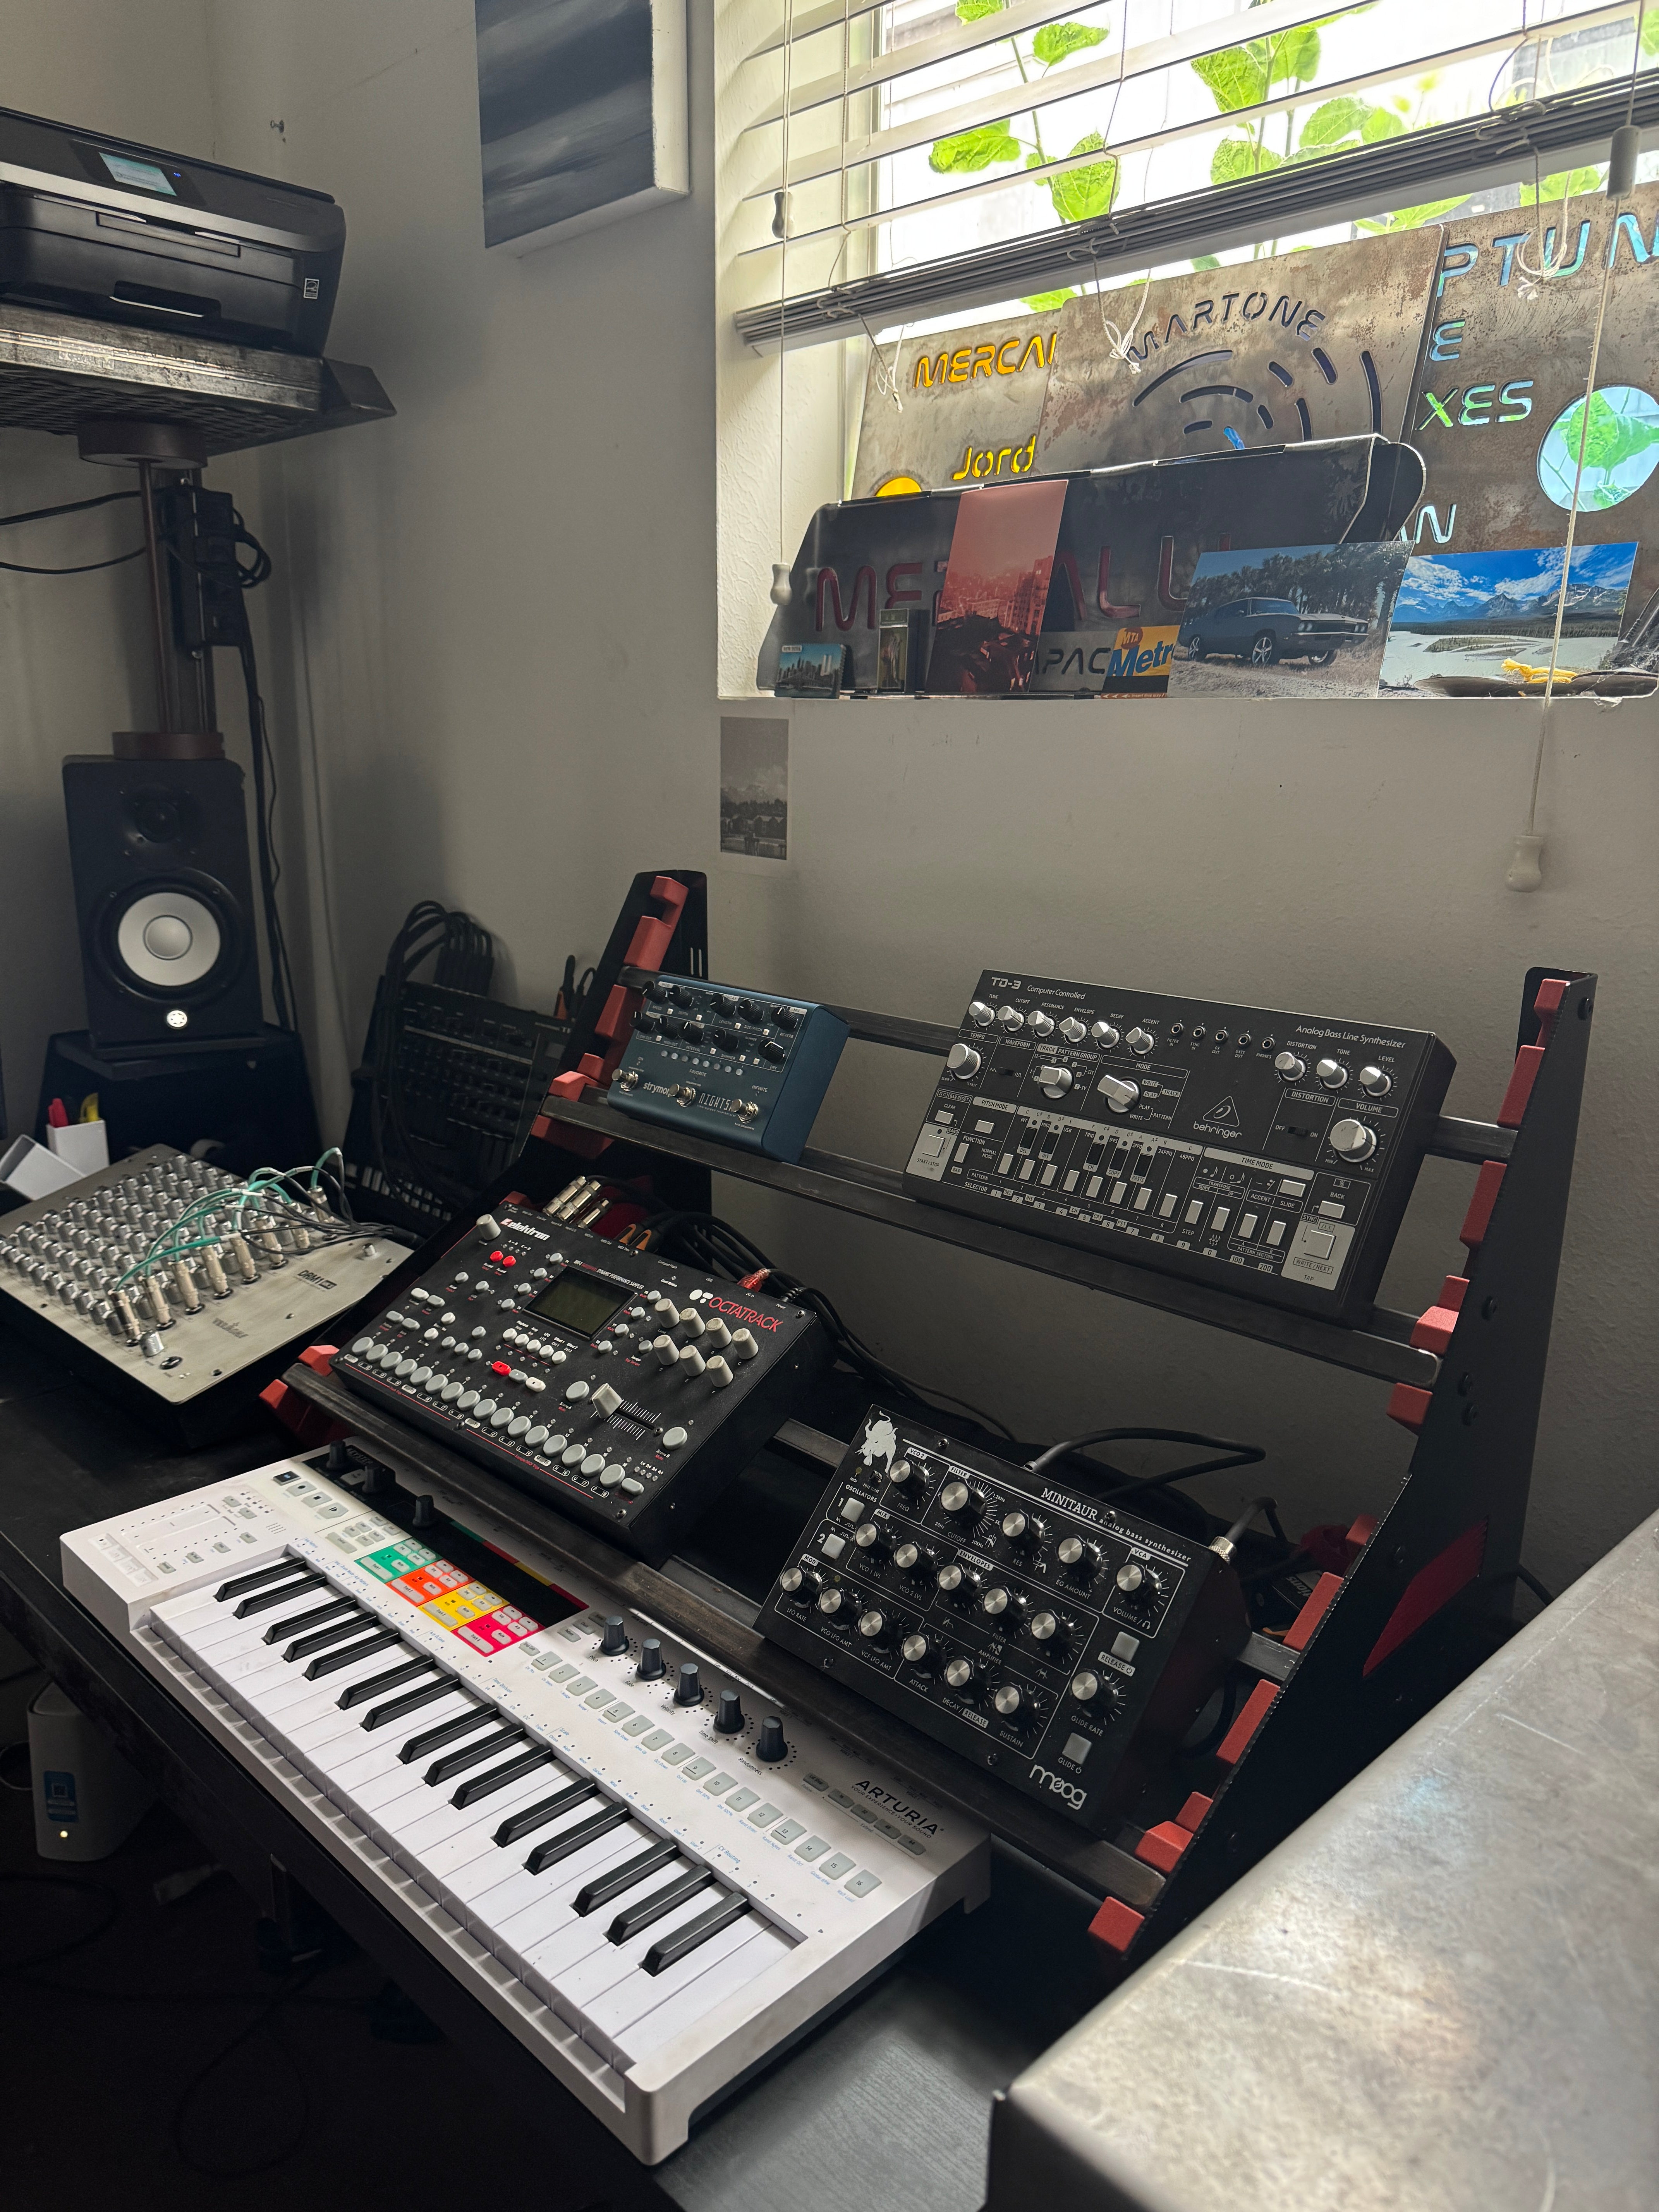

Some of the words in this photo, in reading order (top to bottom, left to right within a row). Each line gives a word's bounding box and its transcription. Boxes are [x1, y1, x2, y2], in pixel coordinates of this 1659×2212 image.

[1127, 292, 1325, 361] MARTONE
[952, 434, 1036, 480] Jord
[1106, 641, 1175, 676] Metr
[991, 977, 1022, 989] TD-3
[1027, 985, 1055, 995] Computer
[1055, 989, 1086, 1000] Controlled
[1041, 1002, 1064, 1010] RESONANCE
[1295, 1025, 1324, 1038] Analog
[1324, 1030, 1342, 1040] Bass
[1343, 1032, 1359, 1041] Line
[1360, 1034, 1406, 1049] Synthesizer
[1005, 1039, 1030, 1049] WAVEFORM
[1286, 1041, 1317, 1050] DISTORTION
[1058, 1048, 1078, 1058] PATTERN
[1079, 1052, 1097, 1061] GROUP
[1291, 1091, 1329, 1103] DISTORTION
[1356, 1103, 1382, 1114] VOLUME
[1153, 1112, 1171, 1121] PATTERN
[1193, 1121, 1242, 1139] behringer
[963, 1135, 986, 1145] FUNCTION
[917, 1158, 939, 1167] START/STOP
[1179, 1154, 1194, 1162] 48PPQ
[1255, 1161, 1273, 1170] MODE
[971, 1172, 989, 1181] PATTERN
[964, 1182, 988, 1192] SELECTOR
[1250, 1194, 1271, 1203] ACCENT
[1280, 1200, 1295, 1209] SLIDE
[507, 1221, 550, 1241] elektron
[1296, 1259, 1330, 1273] WRITE/NEXT
[709, 1297, 783, 1332] OCTATRACK
[910, 1449, 921, 1457] VCO
[951, 1467, 967, 1477] FILTER
[845, 1484, 878, 1503] OSCILLATORS
[838, 1498, 844, 1507] 1
[897, 1503, 909, 1511] FREQ
[877, 1510, 888, 1518] MIX
[1041, 1488, 1099, 1521] MINITAUR
[1099, 1518, 1124, 1534] analog
[1126, 1528, 1143, 1542] bass
[1144, 1538, 1191, 1562] synthesizer
[817, 1533, 824, 1543] 2
[947, 1532, 967, 1544] CUTOFF
[804, 1555, 817, 1565] MOD
[960, 1551, 991, 1569] ENVELOPES
[1134, 1549, 1147, 1559] VCA
[1013, 1558, 1022, 1567] RES
[859, 1563, 870, 1573] VCO
[873, 1570, 881, 1579] LVL
[899, 1585, 910, 1594] VCO
[914, 1592, 923, 1601] LVL
[1063, 1583, 1091, 1599] AMOUNT
[795, 1612, 807, 1622] RATE
[821, 1626, 831, 1636] VCO
[830, 1633, 840, 1642] LFO
[840, 1638, 852, 1648] AMT
[992, 1633, 1006, 1644] FILTER
[862, 1650, 871, 1659] VCF
[870, 1655, 880, 1665] LFO
[879, 1661, 891, 1671] AMT
[978, 1650, 1002, 1665] AMPLIFIER
[1101, 1654, 1126, 1670] RELEASE
[909, 1679, 929, 1693] ATTACK
[963, 1710, 987, 1726] RELEASE
[1071, 1715, 1088, 1729] GLIDE
[1088, 1724, 1104, 1736] RATE
[1000, 1730, 1024, 1747] SUSTAIN
[738, 1757, 763, 1775] Randomness
[1058, 1757, 1075, 1771] GLIDE
[1029, 1764, 1087, 1810] moog
[852, 1786, 865, 1795] YOUR
[865, 1795, 896, 1815] EXPERIENCE
[898, 1815, 912, 1826] YOUR
[912, 1825, 931, 1838] SOUND
[855, 1781, 938, 1835] ARTURIA
